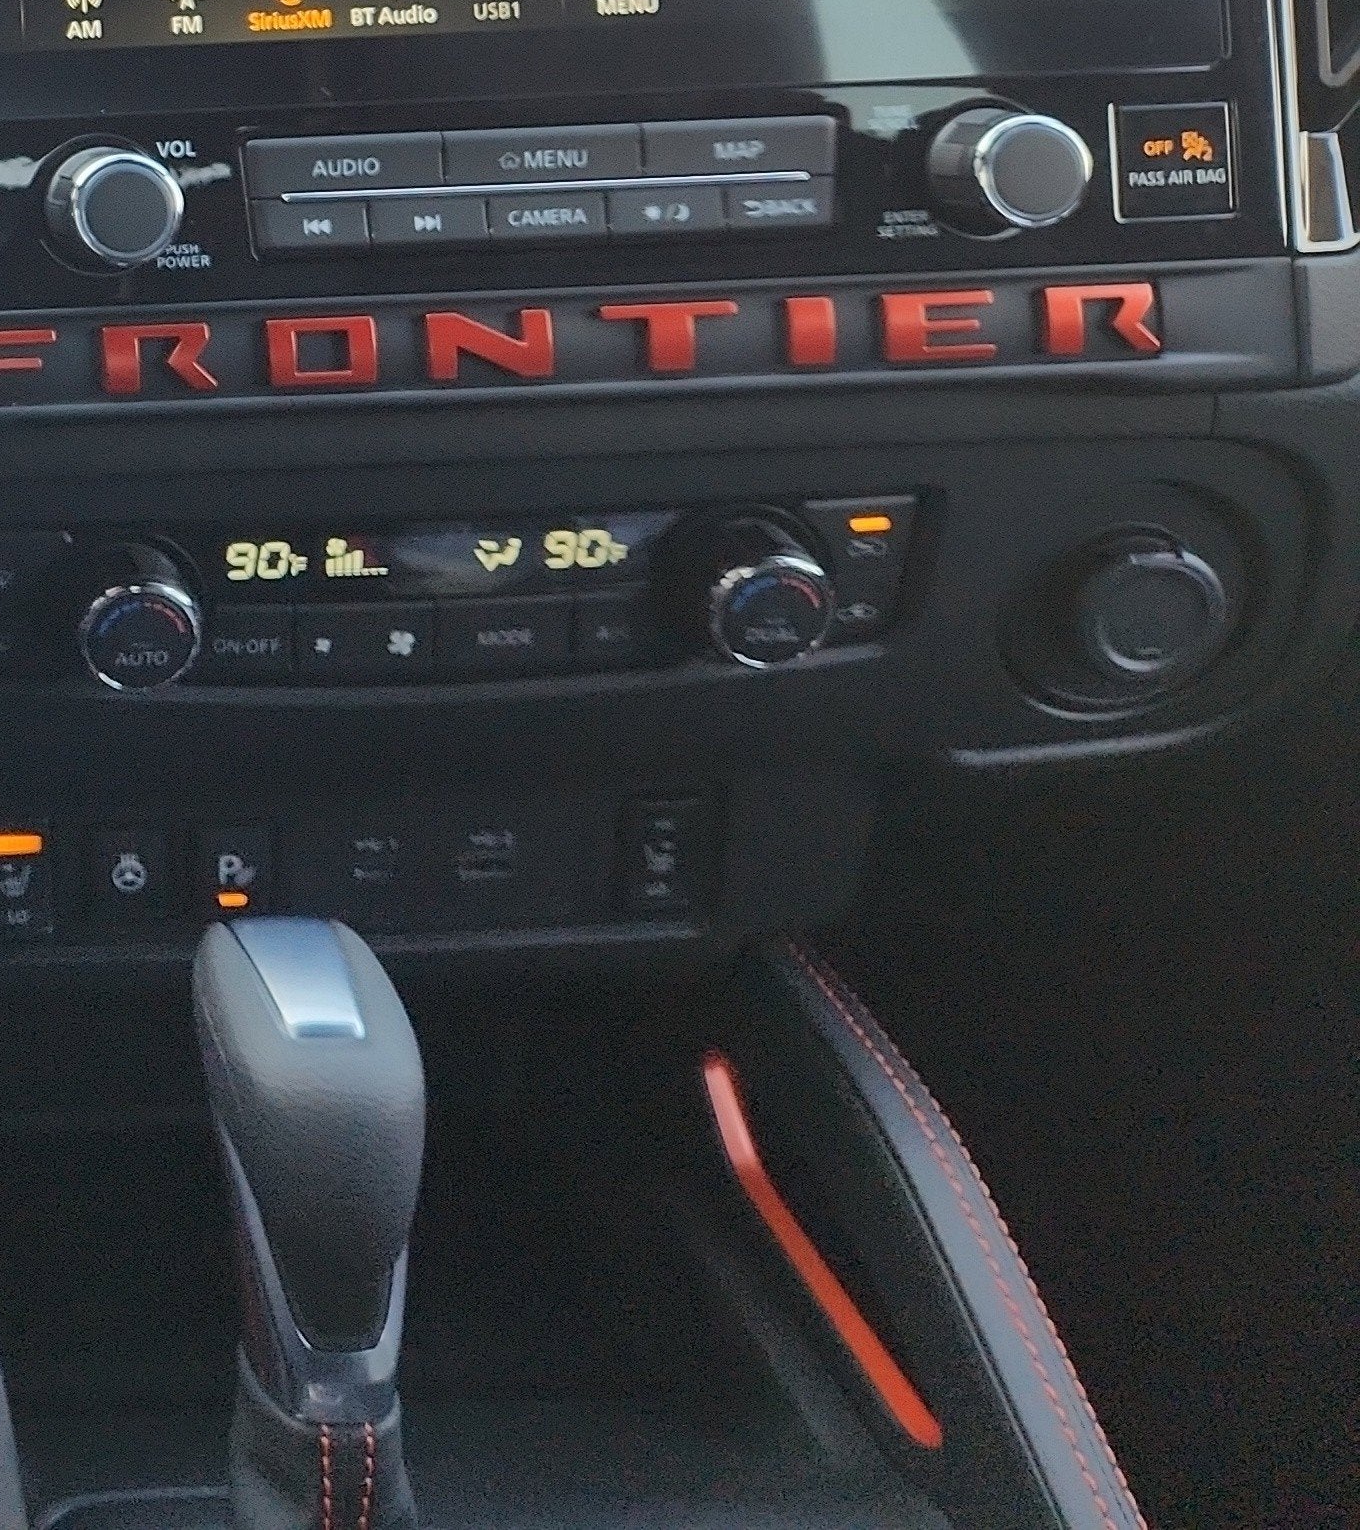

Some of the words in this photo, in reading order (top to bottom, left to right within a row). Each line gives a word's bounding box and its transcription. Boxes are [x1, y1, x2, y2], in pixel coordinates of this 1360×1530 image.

[247, 8, 333, 31] SiriusXM
[349, 7, 375, 27] BT
[377, 4, 439, 25] Audio
[473, 1, 521, 20] USB1
[65, 19, 103, 39] AM
[171, 15, 203, 34] FM
[156, 140, 196, 158] VOL
[1143, 139, 1174, 157] OFF
[312, 157, 381, 178] AUDIO
[523, 149, 590, 170] MENU
[1128, 171, 1165, 187] PASS
[1168, 169, 1193, 185] AIR
[1196, 167, 1227, 184] BAG
[507, 207, 588, 228] CAMERA
[157, 254, 210, 269] POWER
[114, 649, 170, 667] AUTO
